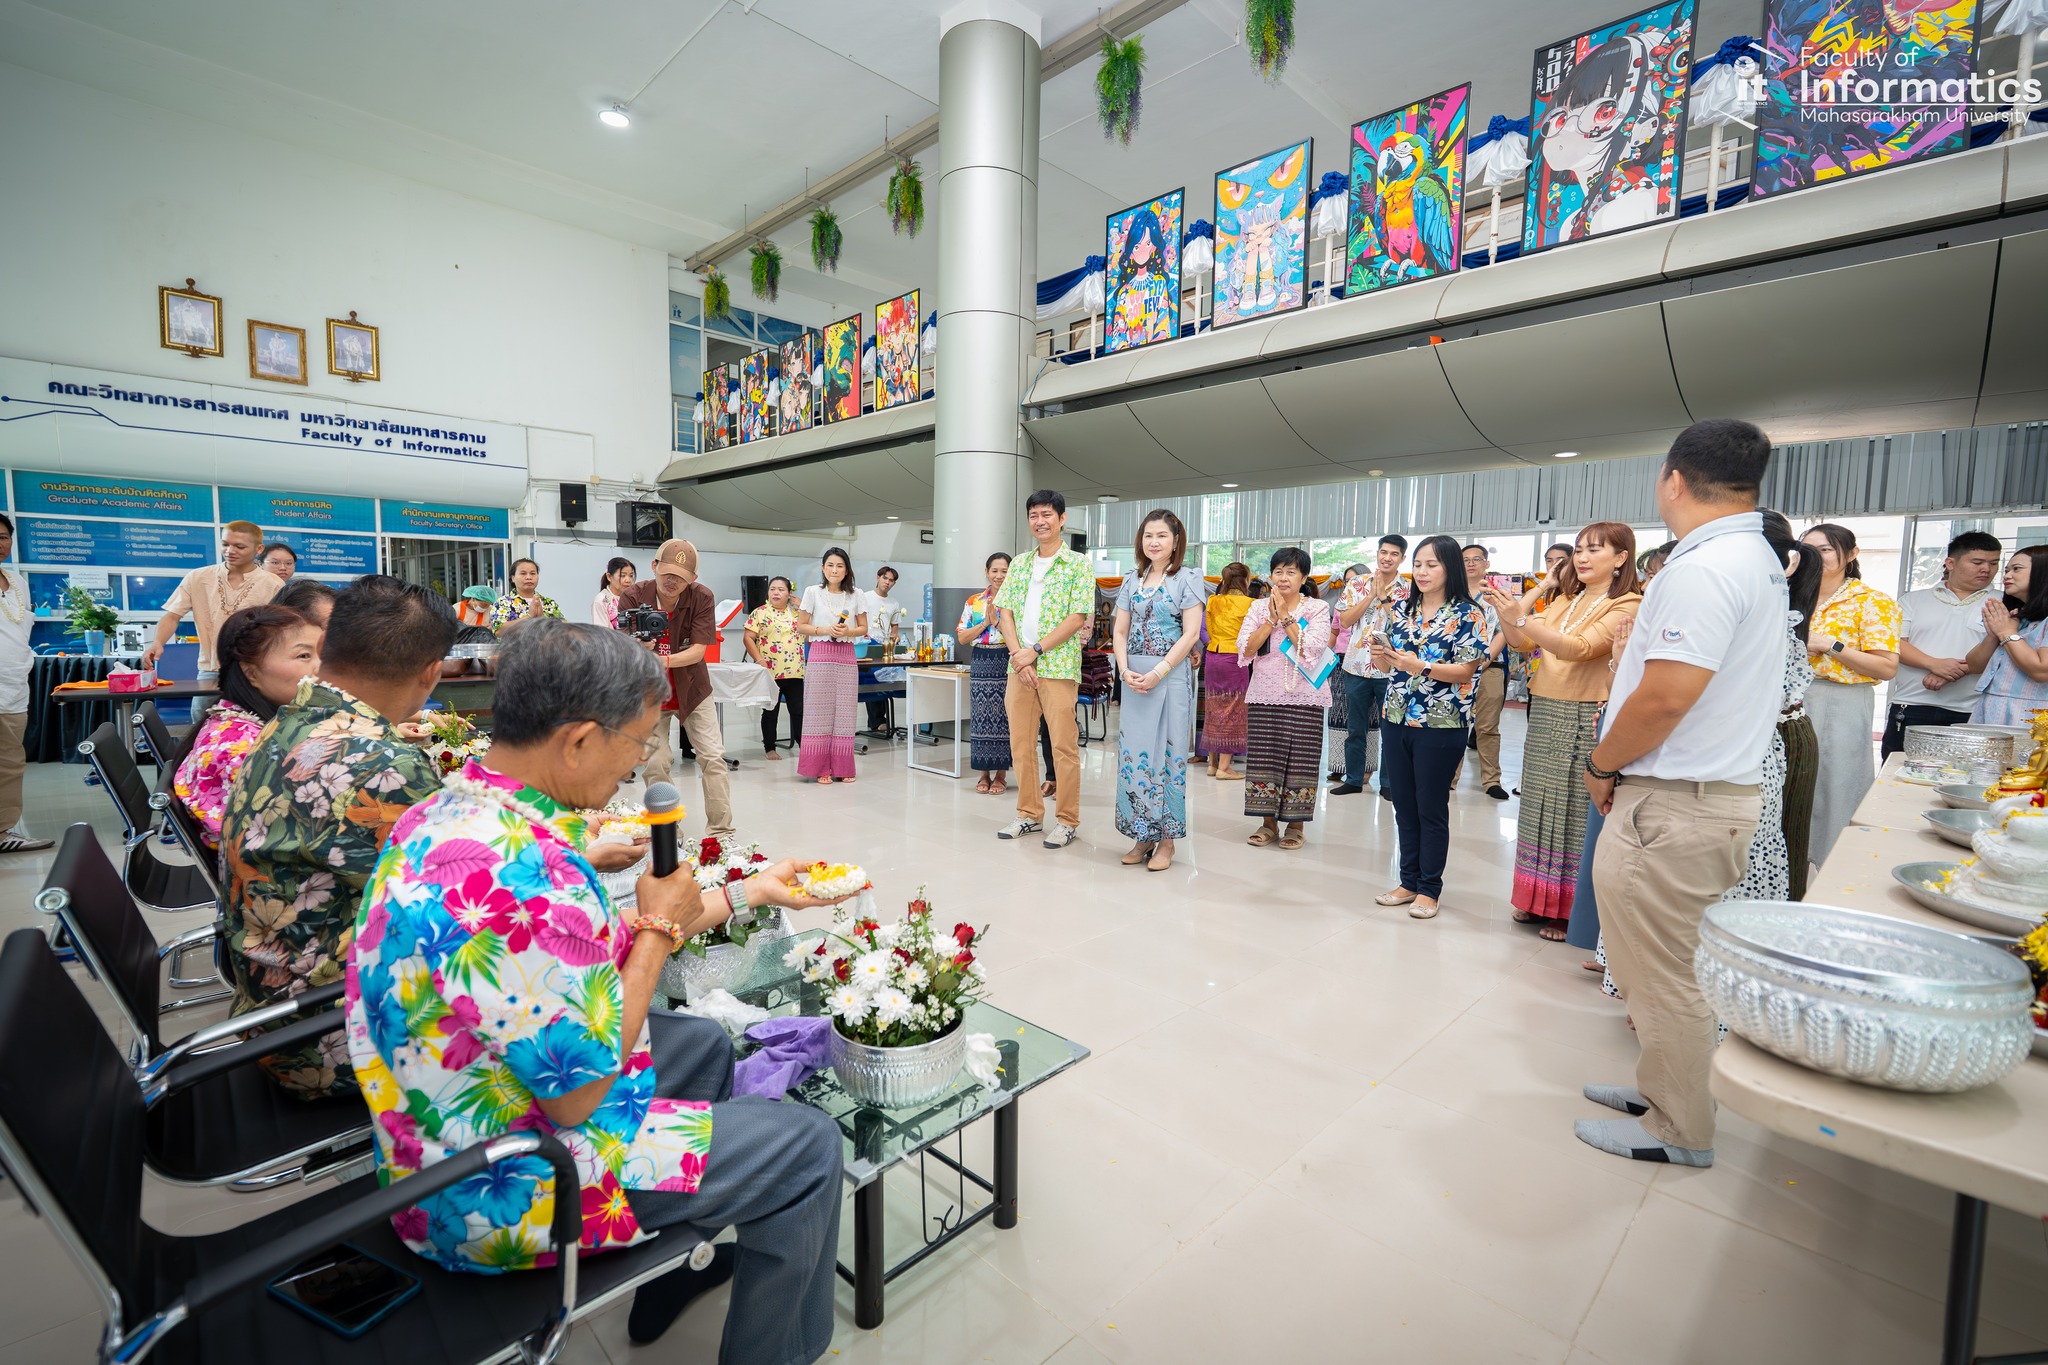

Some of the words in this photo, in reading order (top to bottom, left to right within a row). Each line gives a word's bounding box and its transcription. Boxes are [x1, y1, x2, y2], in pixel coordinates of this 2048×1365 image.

[48, 380, 289, 421] คณะวิทยาการสารสนเทศ
[300, 412, 487, 444] มหาวิทยาลัยมหาสารคาม
[302, 428, 362, 446] Faculty
[374, 437, 393, 448] of
[403, 440, 487, 458] Informatics
[47, 495, 98, 505] Graduate
[101, 498, 151, 509] Academic
[153, 501, 183, 511] Affairs
[274, 509, 305, 518] Student
[307, 511, 333, 520] Affairs
[410, 519, 433, 528] Faculty
[434, 521, 464, 530] Secretary
